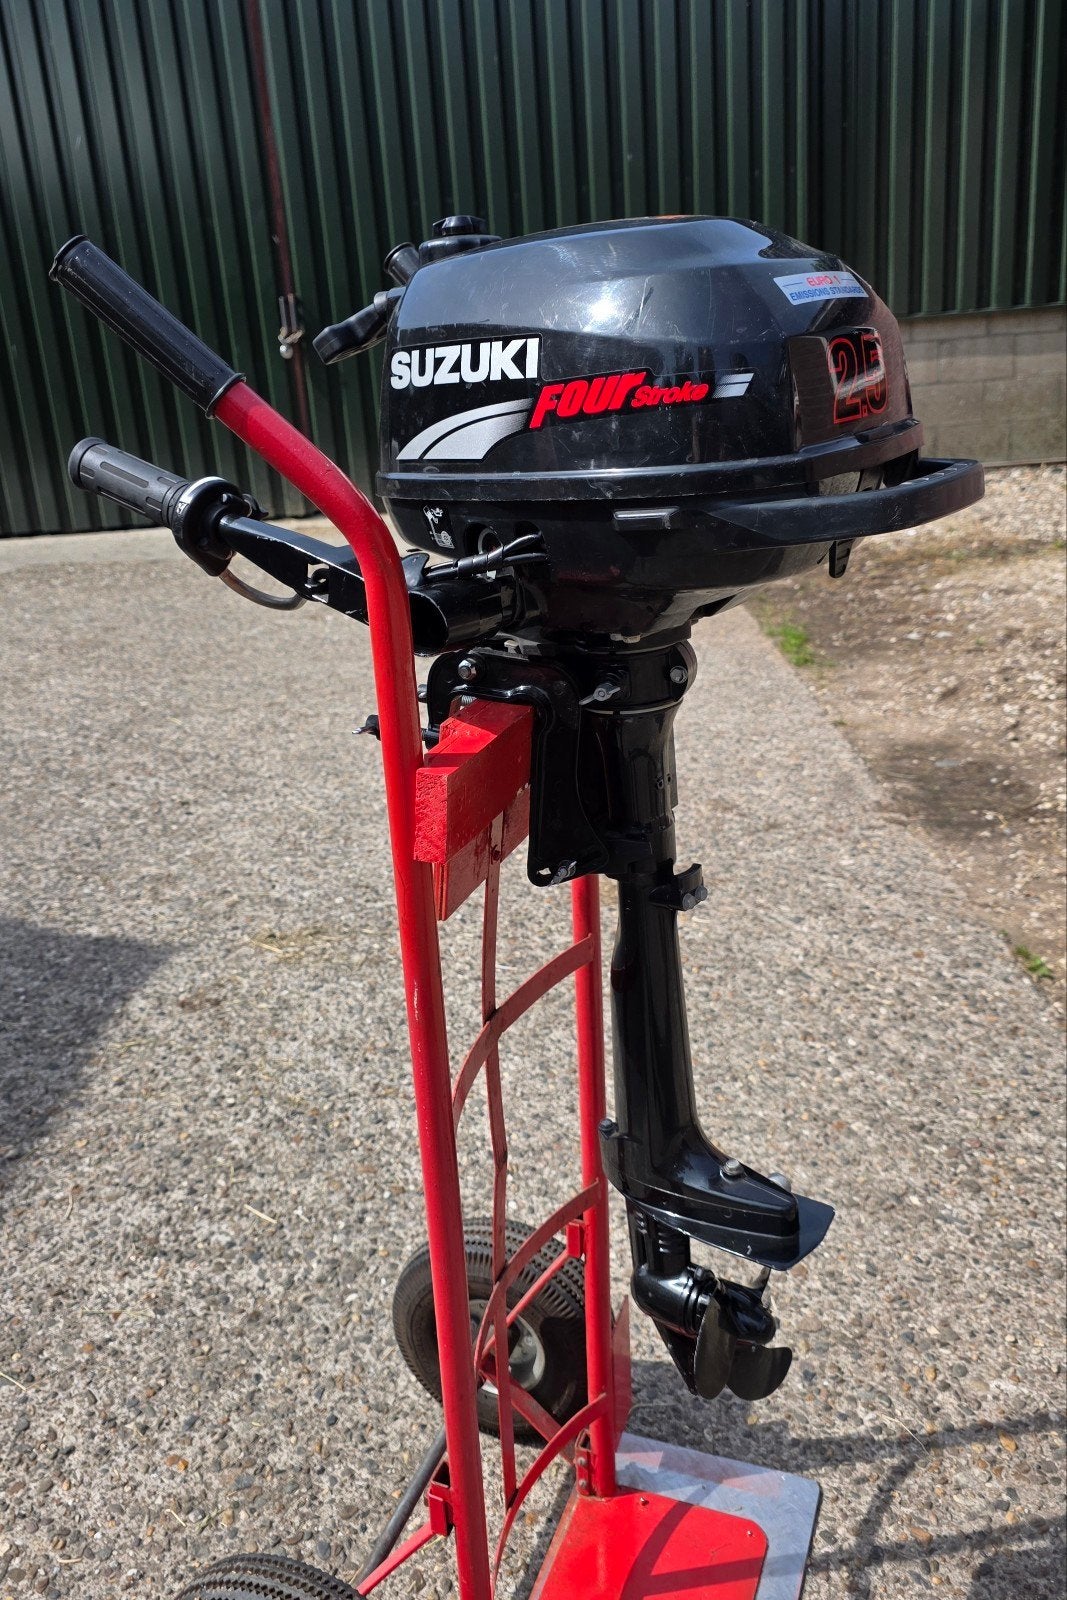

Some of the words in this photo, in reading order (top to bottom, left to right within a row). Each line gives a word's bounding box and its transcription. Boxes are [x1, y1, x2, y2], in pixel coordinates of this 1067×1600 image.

[789, 286, 831, 301] EMISSIONS
[830, 285, 865, 296] STANDARDS
[806, 275, 833, 287] EURO
[390, 337, 540, 390] SUZUKI
[828, 333, 888, 424] 2.5
[631, 381, 710, 408] Stroke
